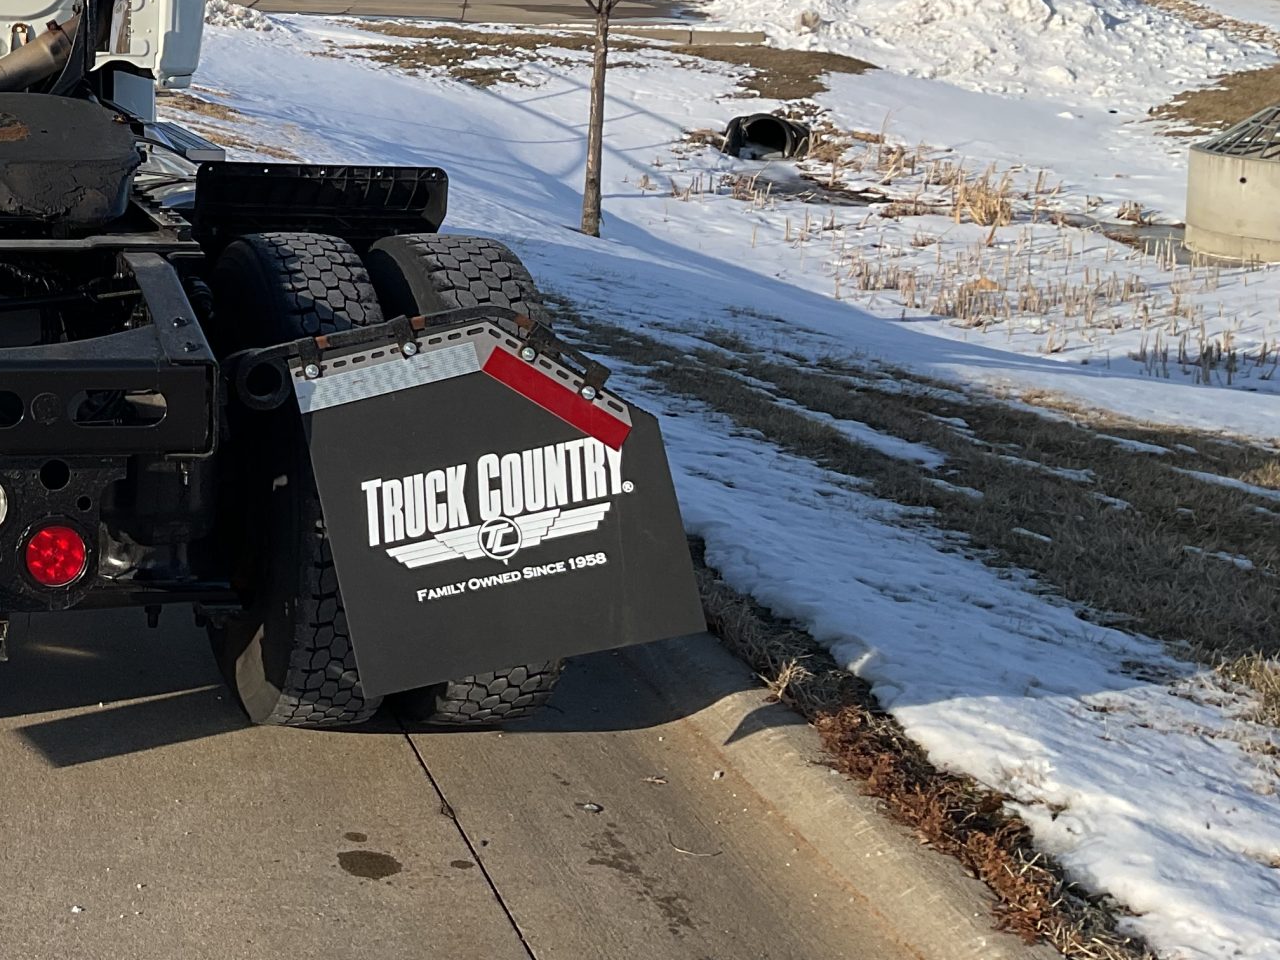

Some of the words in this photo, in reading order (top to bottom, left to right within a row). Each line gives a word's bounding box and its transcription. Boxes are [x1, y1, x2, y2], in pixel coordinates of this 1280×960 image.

[361, 463, 470, 547] TRUCK
[417, 581, 467, 602] FAMILY
[468, 570, 521, 591] OWNED
[523, 561, 566, 580] SINCE
[568, 552, 608, 571] 1958
